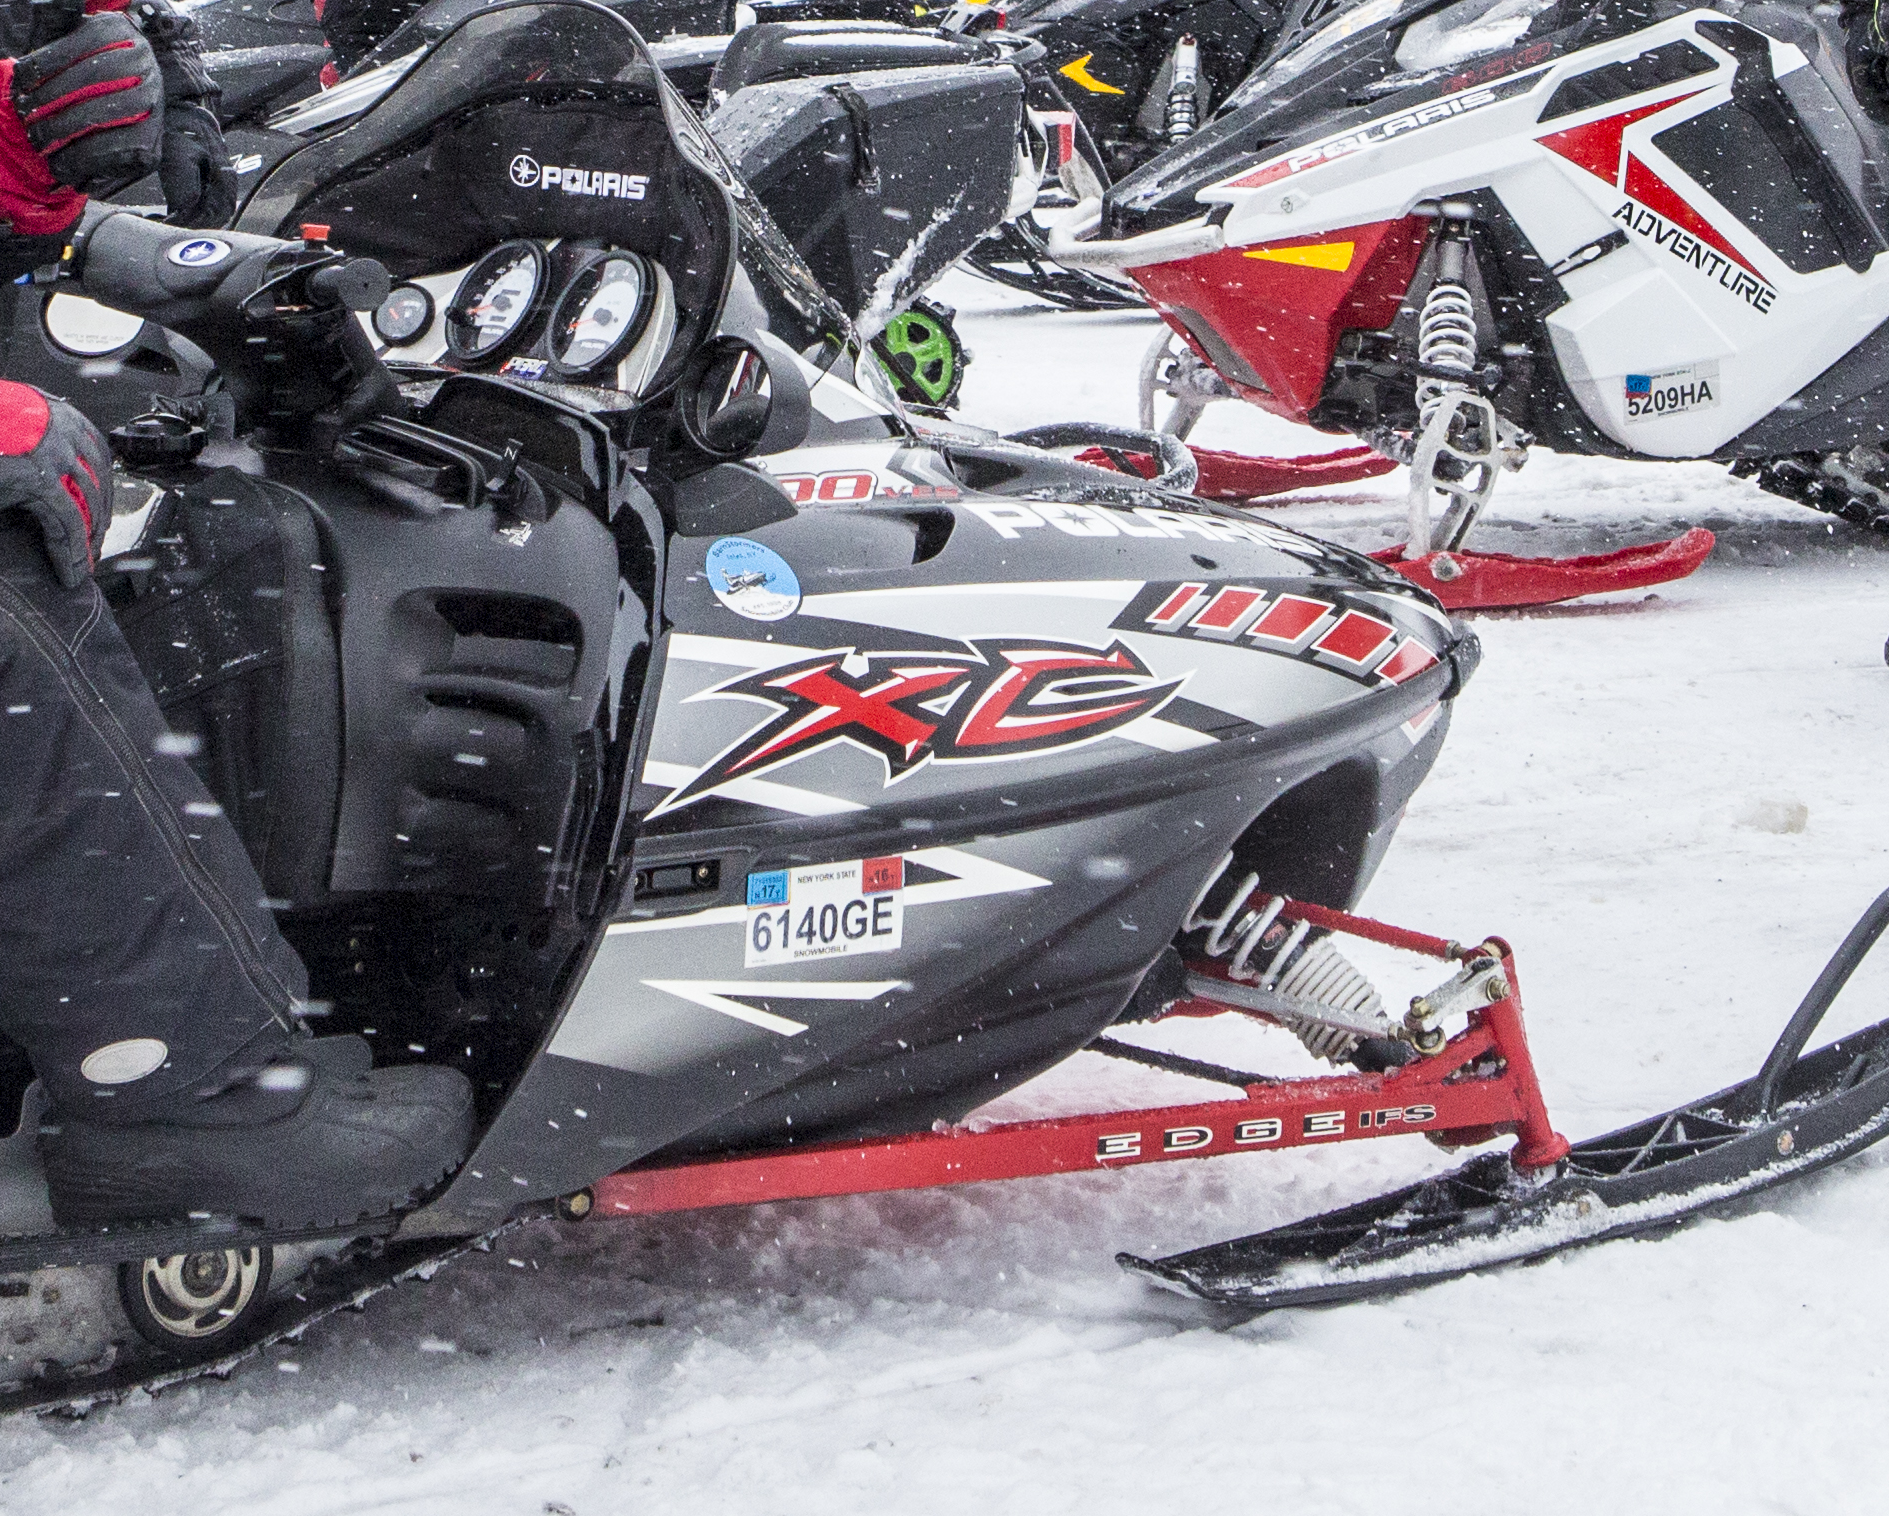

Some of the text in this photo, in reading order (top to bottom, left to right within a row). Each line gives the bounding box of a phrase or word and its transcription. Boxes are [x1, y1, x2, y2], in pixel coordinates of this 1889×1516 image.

[1289, 89, 1496, 173] POLARIS
[541, 165, 647, 200] POLARIS
[1611, 201, 1776, 314] ADVENTURE
[1628, 381, 1713, 416] 5209HA
[962, 501, 1324, 557] POLARIS
[671, 636, 1191, 796] XC
[762, 885, 774, 898] 17
[797, 870, 856, 884] NEW YORK STATE
[752, 895, 894, 952] 6140GE
[794, 944, 848, 958] SNOWMOBILE
[1096, 1105, 1437, 1162] EDGE IFS
